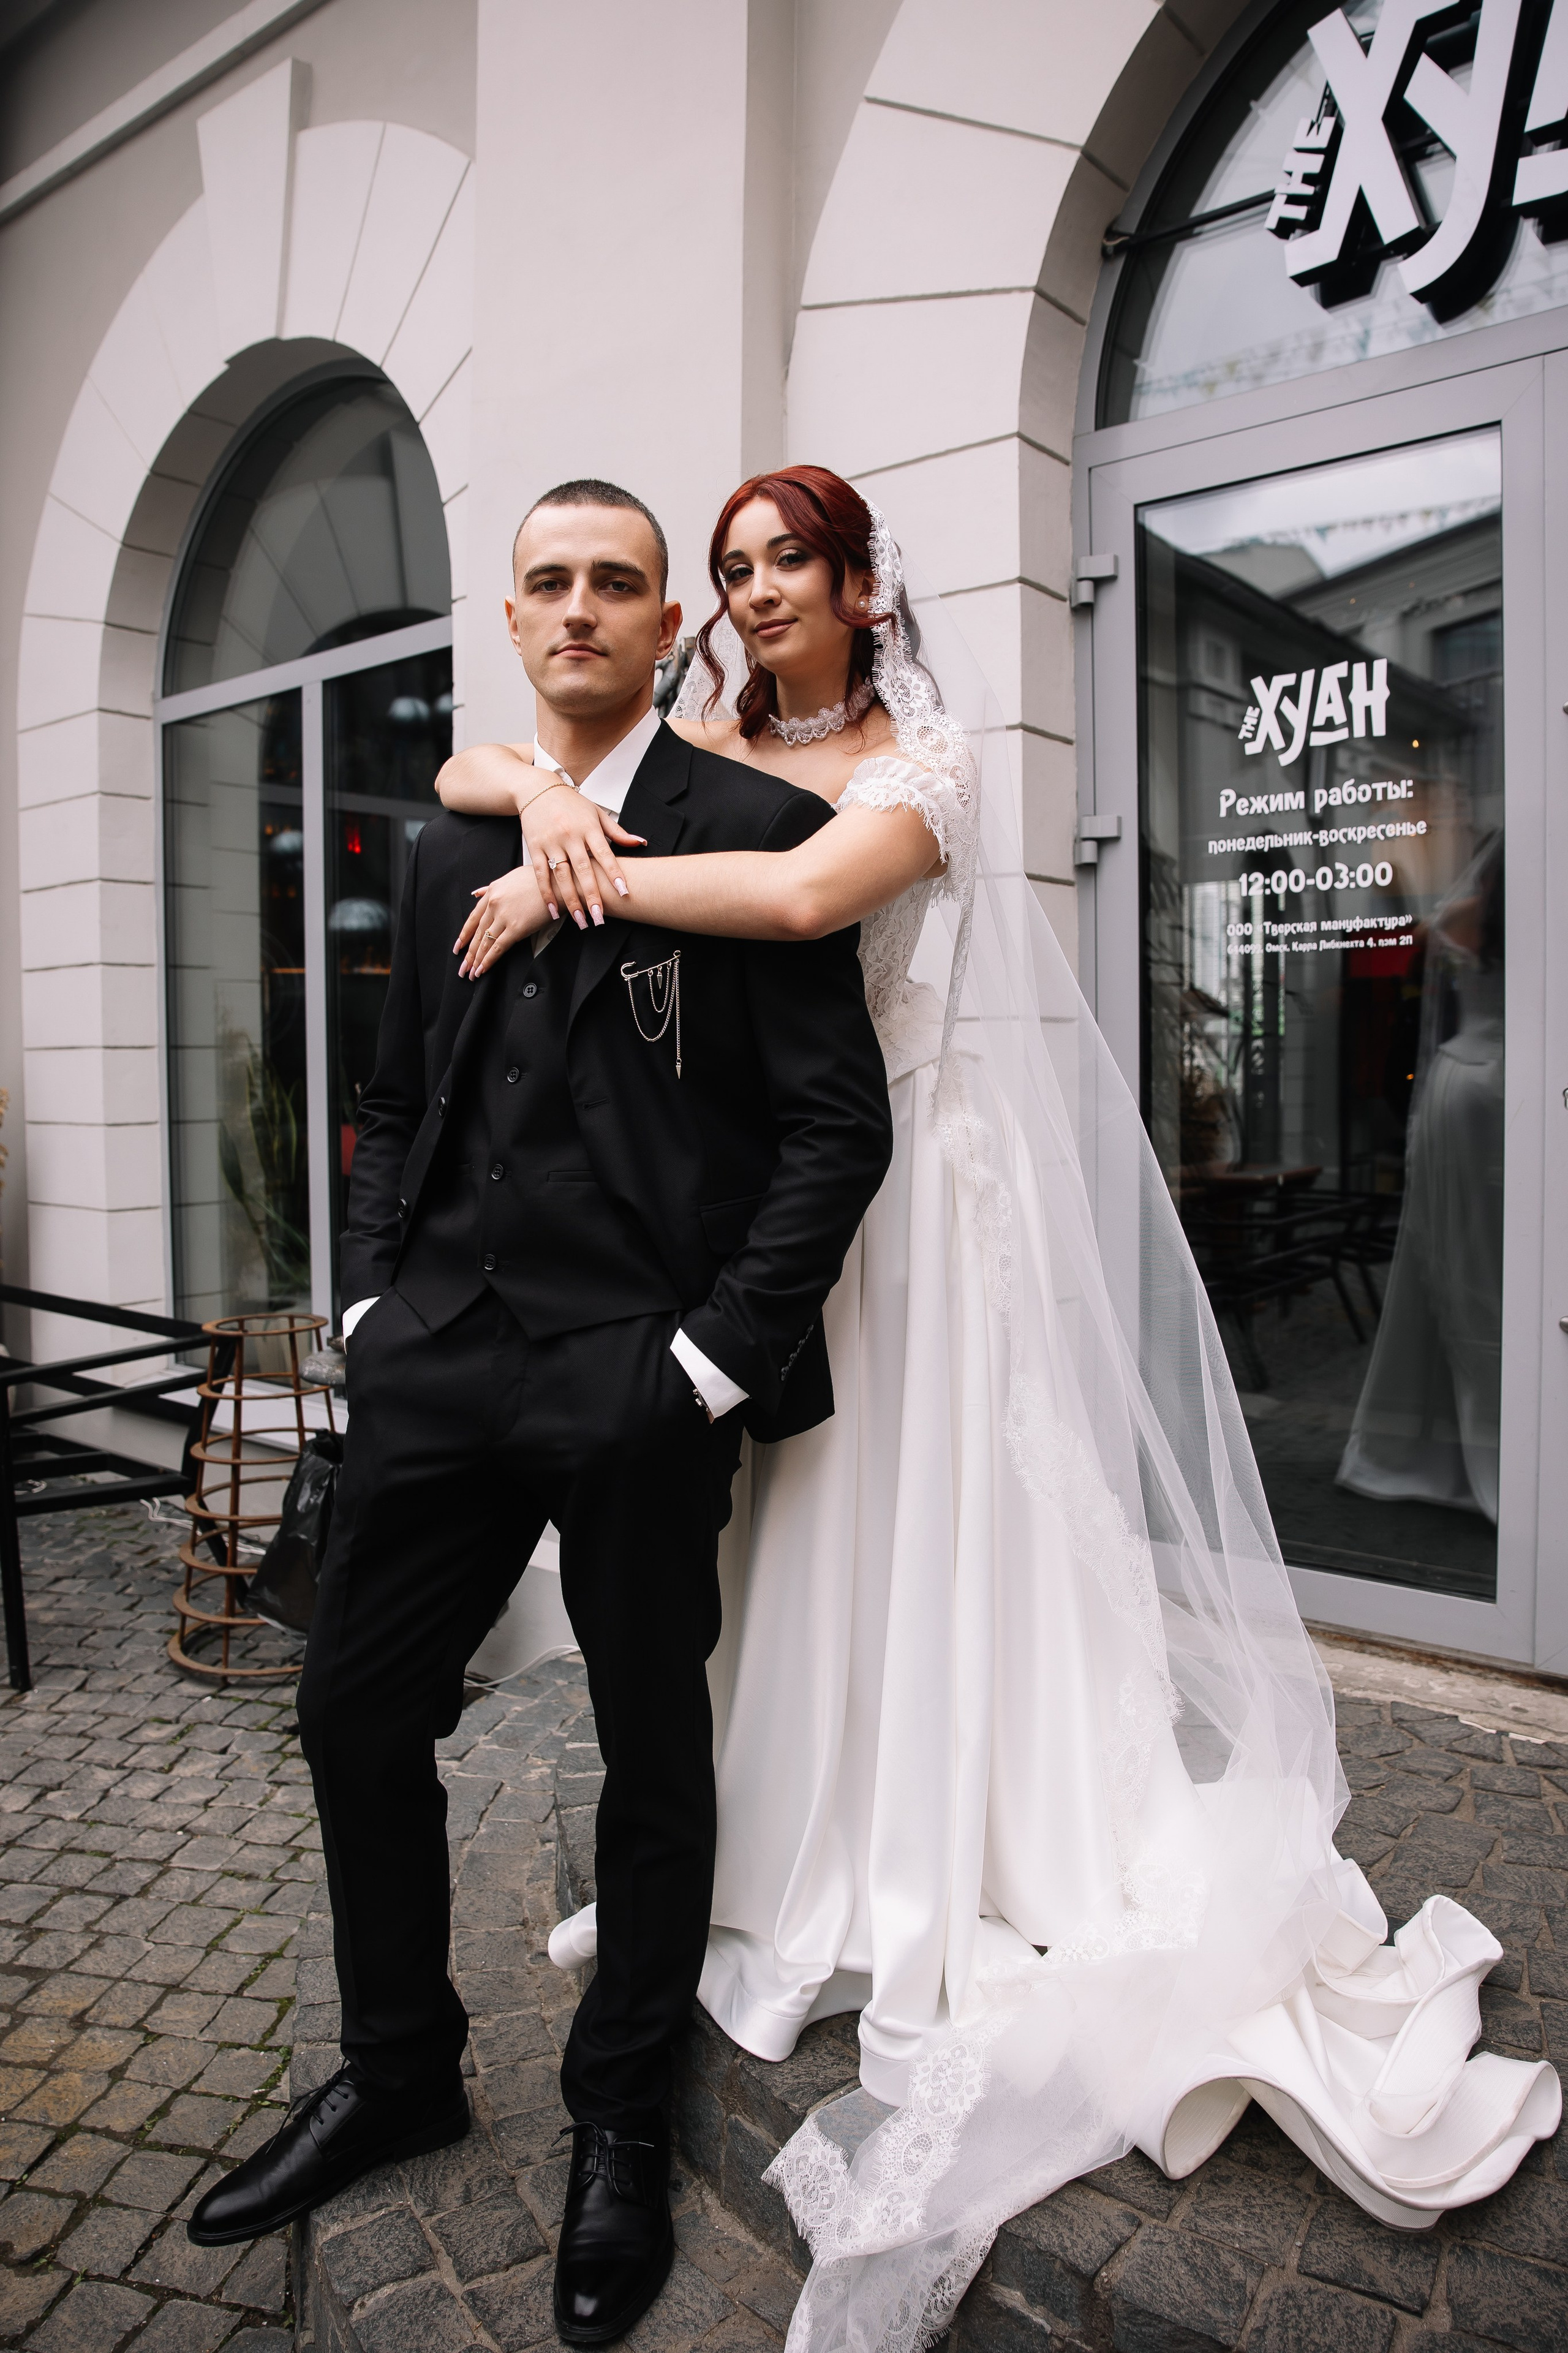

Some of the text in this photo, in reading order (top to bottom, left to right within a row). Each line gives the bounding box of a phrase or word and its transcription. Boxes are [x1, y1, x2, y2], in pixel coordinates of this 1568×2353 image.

[1264, 116, 1337, 230] THE
[1238, 705, 1261, 740] THE
[1244, 657, 1391, 768] ХУАН
[1219, 777, 1414, 818] Режим работы:
[1207, 820, 1428, 855] понедельник-воскресенье
[1238, 860, 1394, 897] 12:00-03:00
[1226, 922, 1254, 937] ООО
[1320, 914, 1413, 933] мануфактура»
